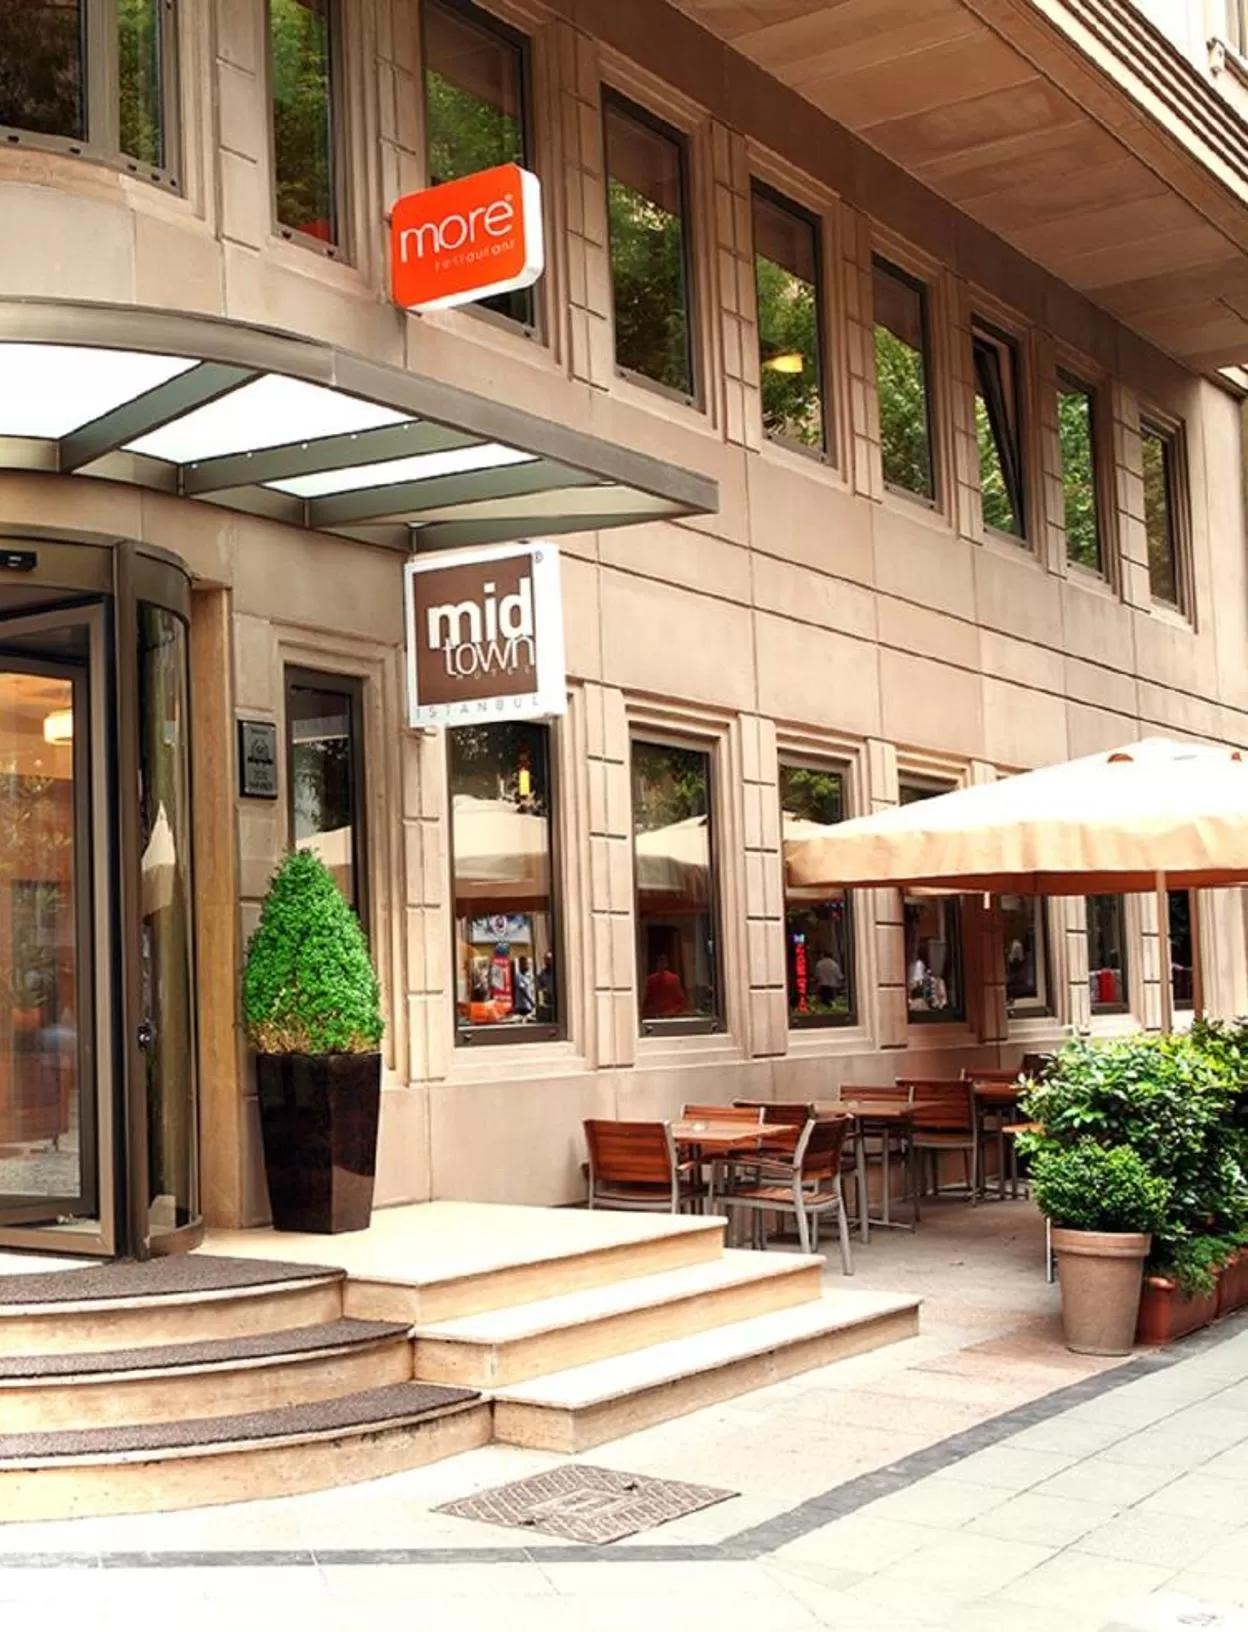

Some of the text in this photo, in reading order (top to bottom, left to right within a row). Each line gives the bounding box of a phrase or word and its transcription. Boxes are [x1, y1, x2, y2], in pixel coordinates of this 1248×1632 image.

[400, 200, 513, 263] more
[427, 577, 533, 649] mid
[444, 637, 534, 675] town
